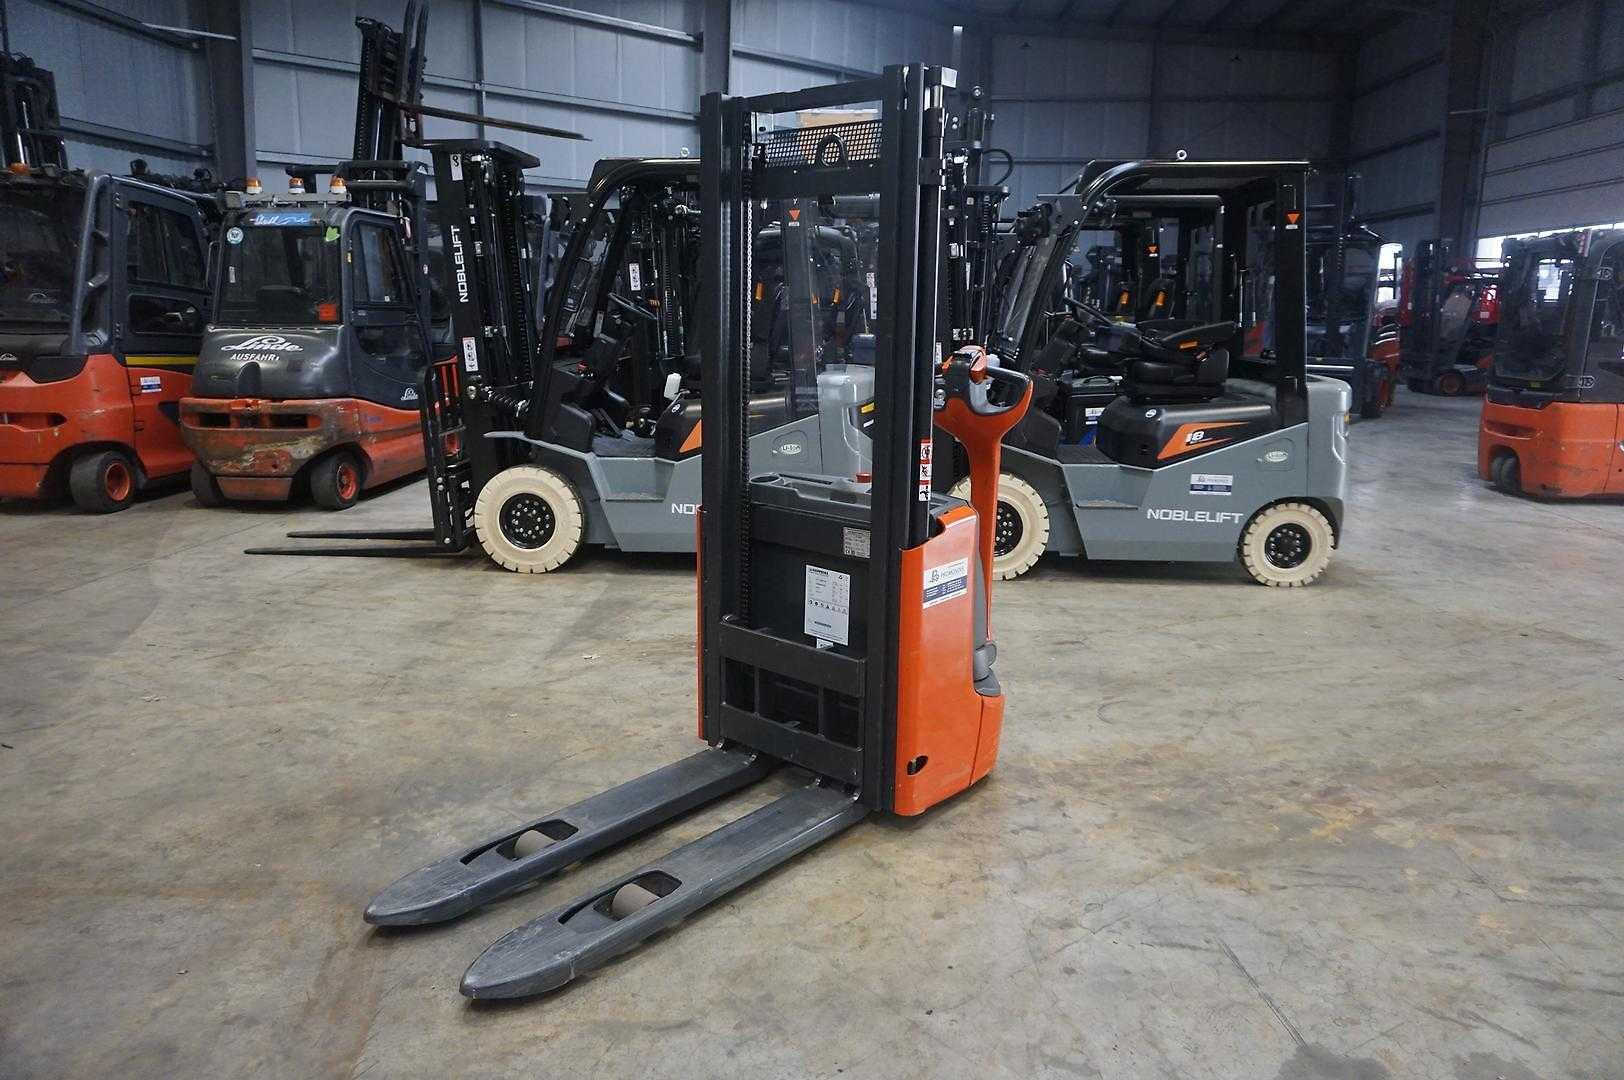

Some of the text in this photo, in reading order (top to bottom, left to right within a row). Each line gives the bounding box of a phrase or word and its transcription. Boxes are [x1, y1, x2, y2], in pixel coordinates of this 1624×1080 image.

[450, 225, 469, 303] NOBLELIFT
[220, 335, 304, 352] Linde
[1146, 508, 1244, 524] NOBLELIFT
